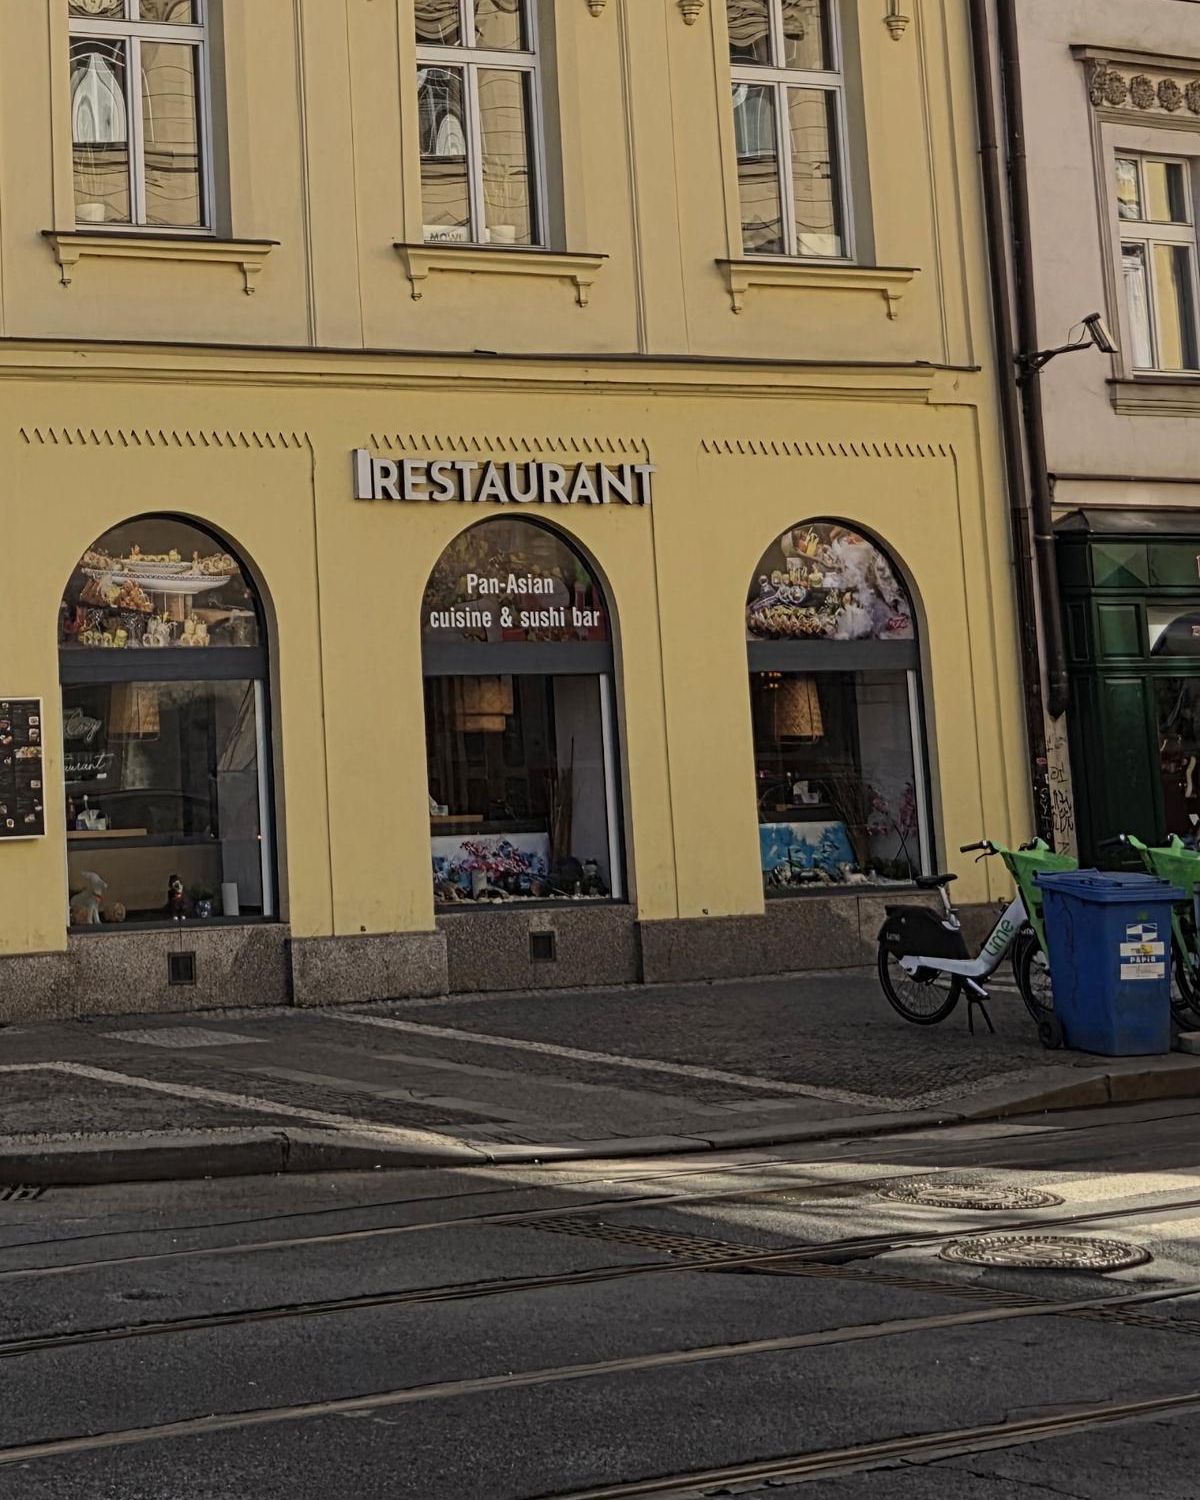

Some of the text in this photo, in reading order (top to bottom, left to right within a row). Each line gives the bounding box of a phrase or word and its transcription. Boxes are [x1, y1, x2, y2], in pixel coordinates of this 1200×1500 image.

[371, 457, 657, 505] RESTAURANT
[467, 573, 554, 594] Pan-Asian
[430, 606, 600, 628] cuisine & sushi bar
[985, 919, 1014, 957] Lime
